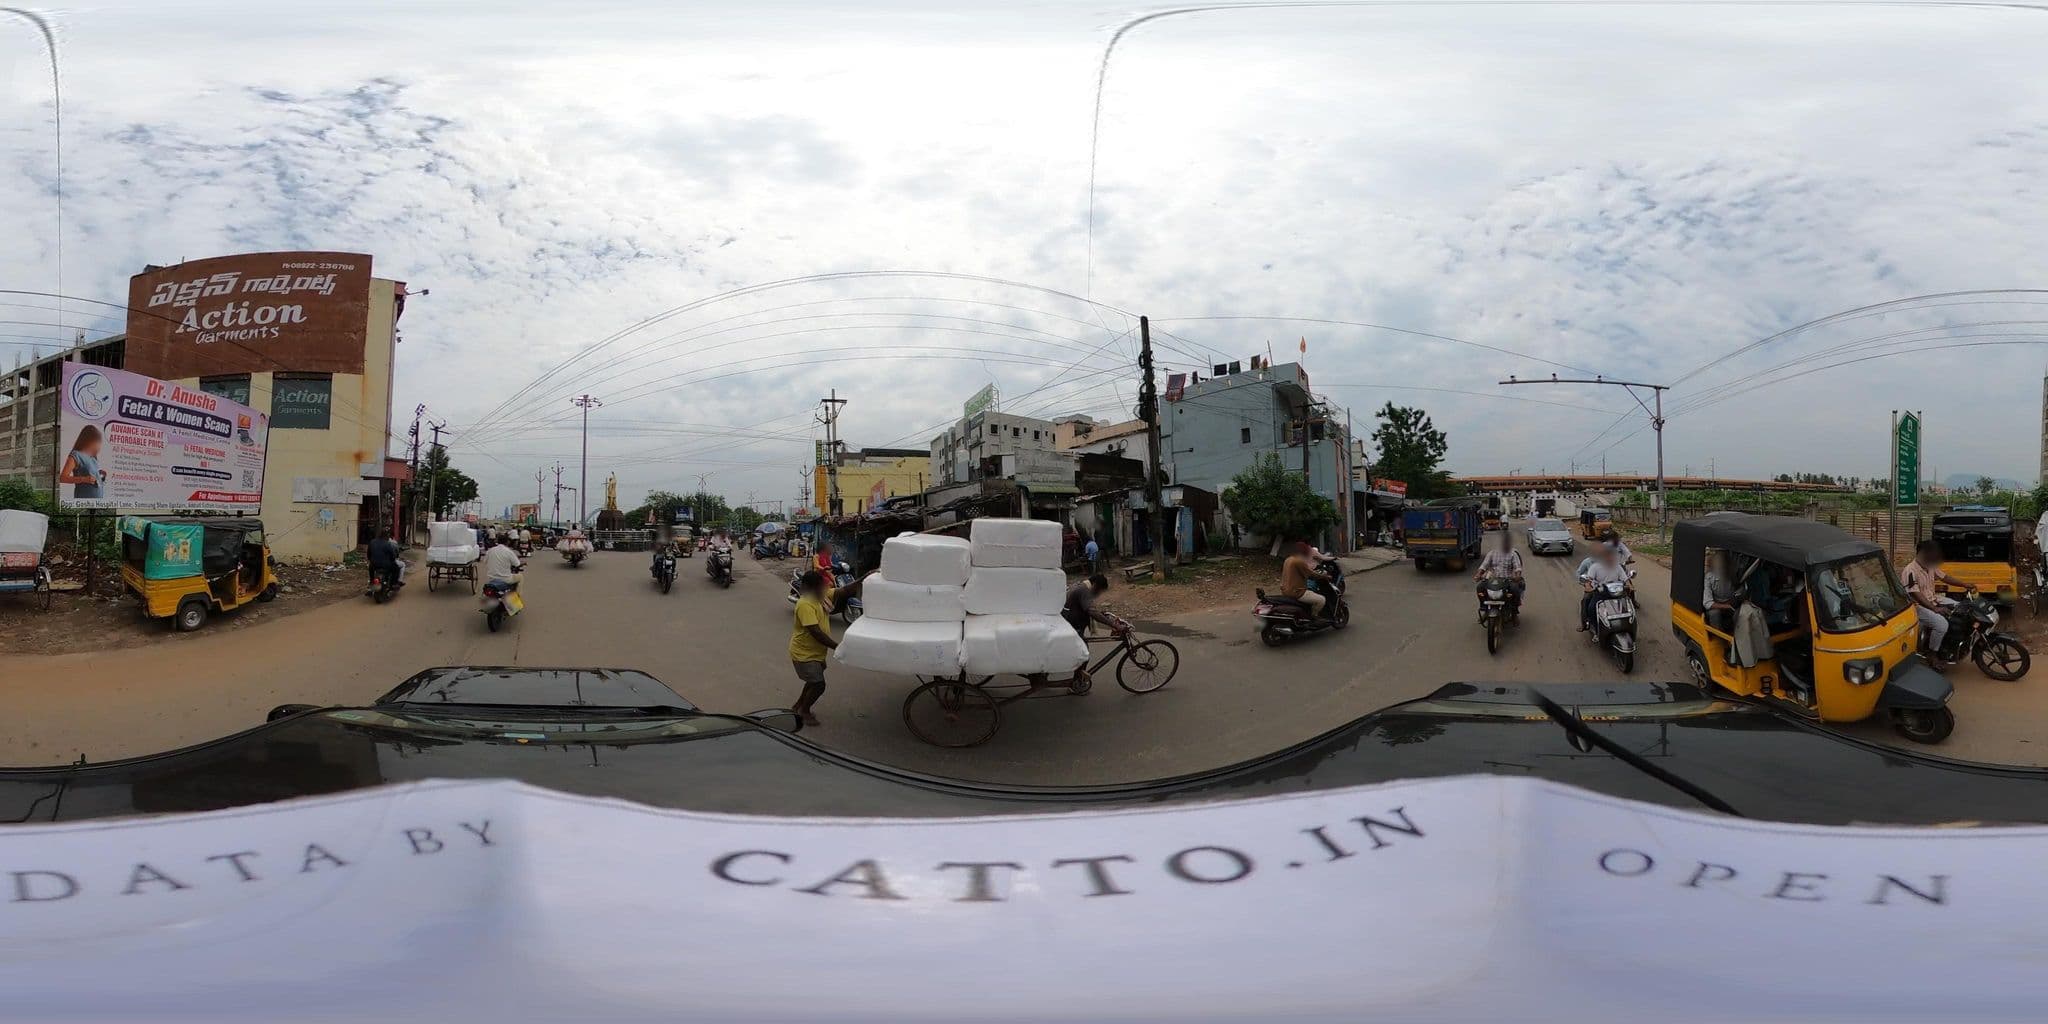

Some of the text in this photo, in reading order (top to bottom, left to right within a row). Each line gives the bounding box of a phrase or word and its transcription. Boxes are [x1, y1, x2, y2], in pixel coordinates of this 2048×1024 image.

[175, 301, 307, 333] Action
[195, 326, 279, 345] Garments
[146, 380, 166, 399] Dr.
[171, 386, 217, 411] Anusha
[275, 387, 329, 404] Action
[122, 398, 230, 434] Fetal & Women Scans
[278, 405, 322, 415] Garments
[109, 435, 165, 449] AFFORDABLE PRICE
[111, 424, 164, 439] ADVANCE SCAN AT
[204, 447, 226, 458] MEDICINE
[8, 818, 498, 902] DATA BY
[710, 804, 1427, 901] CATTO.IN
[1598, 847, 1952, 905] OPEN
